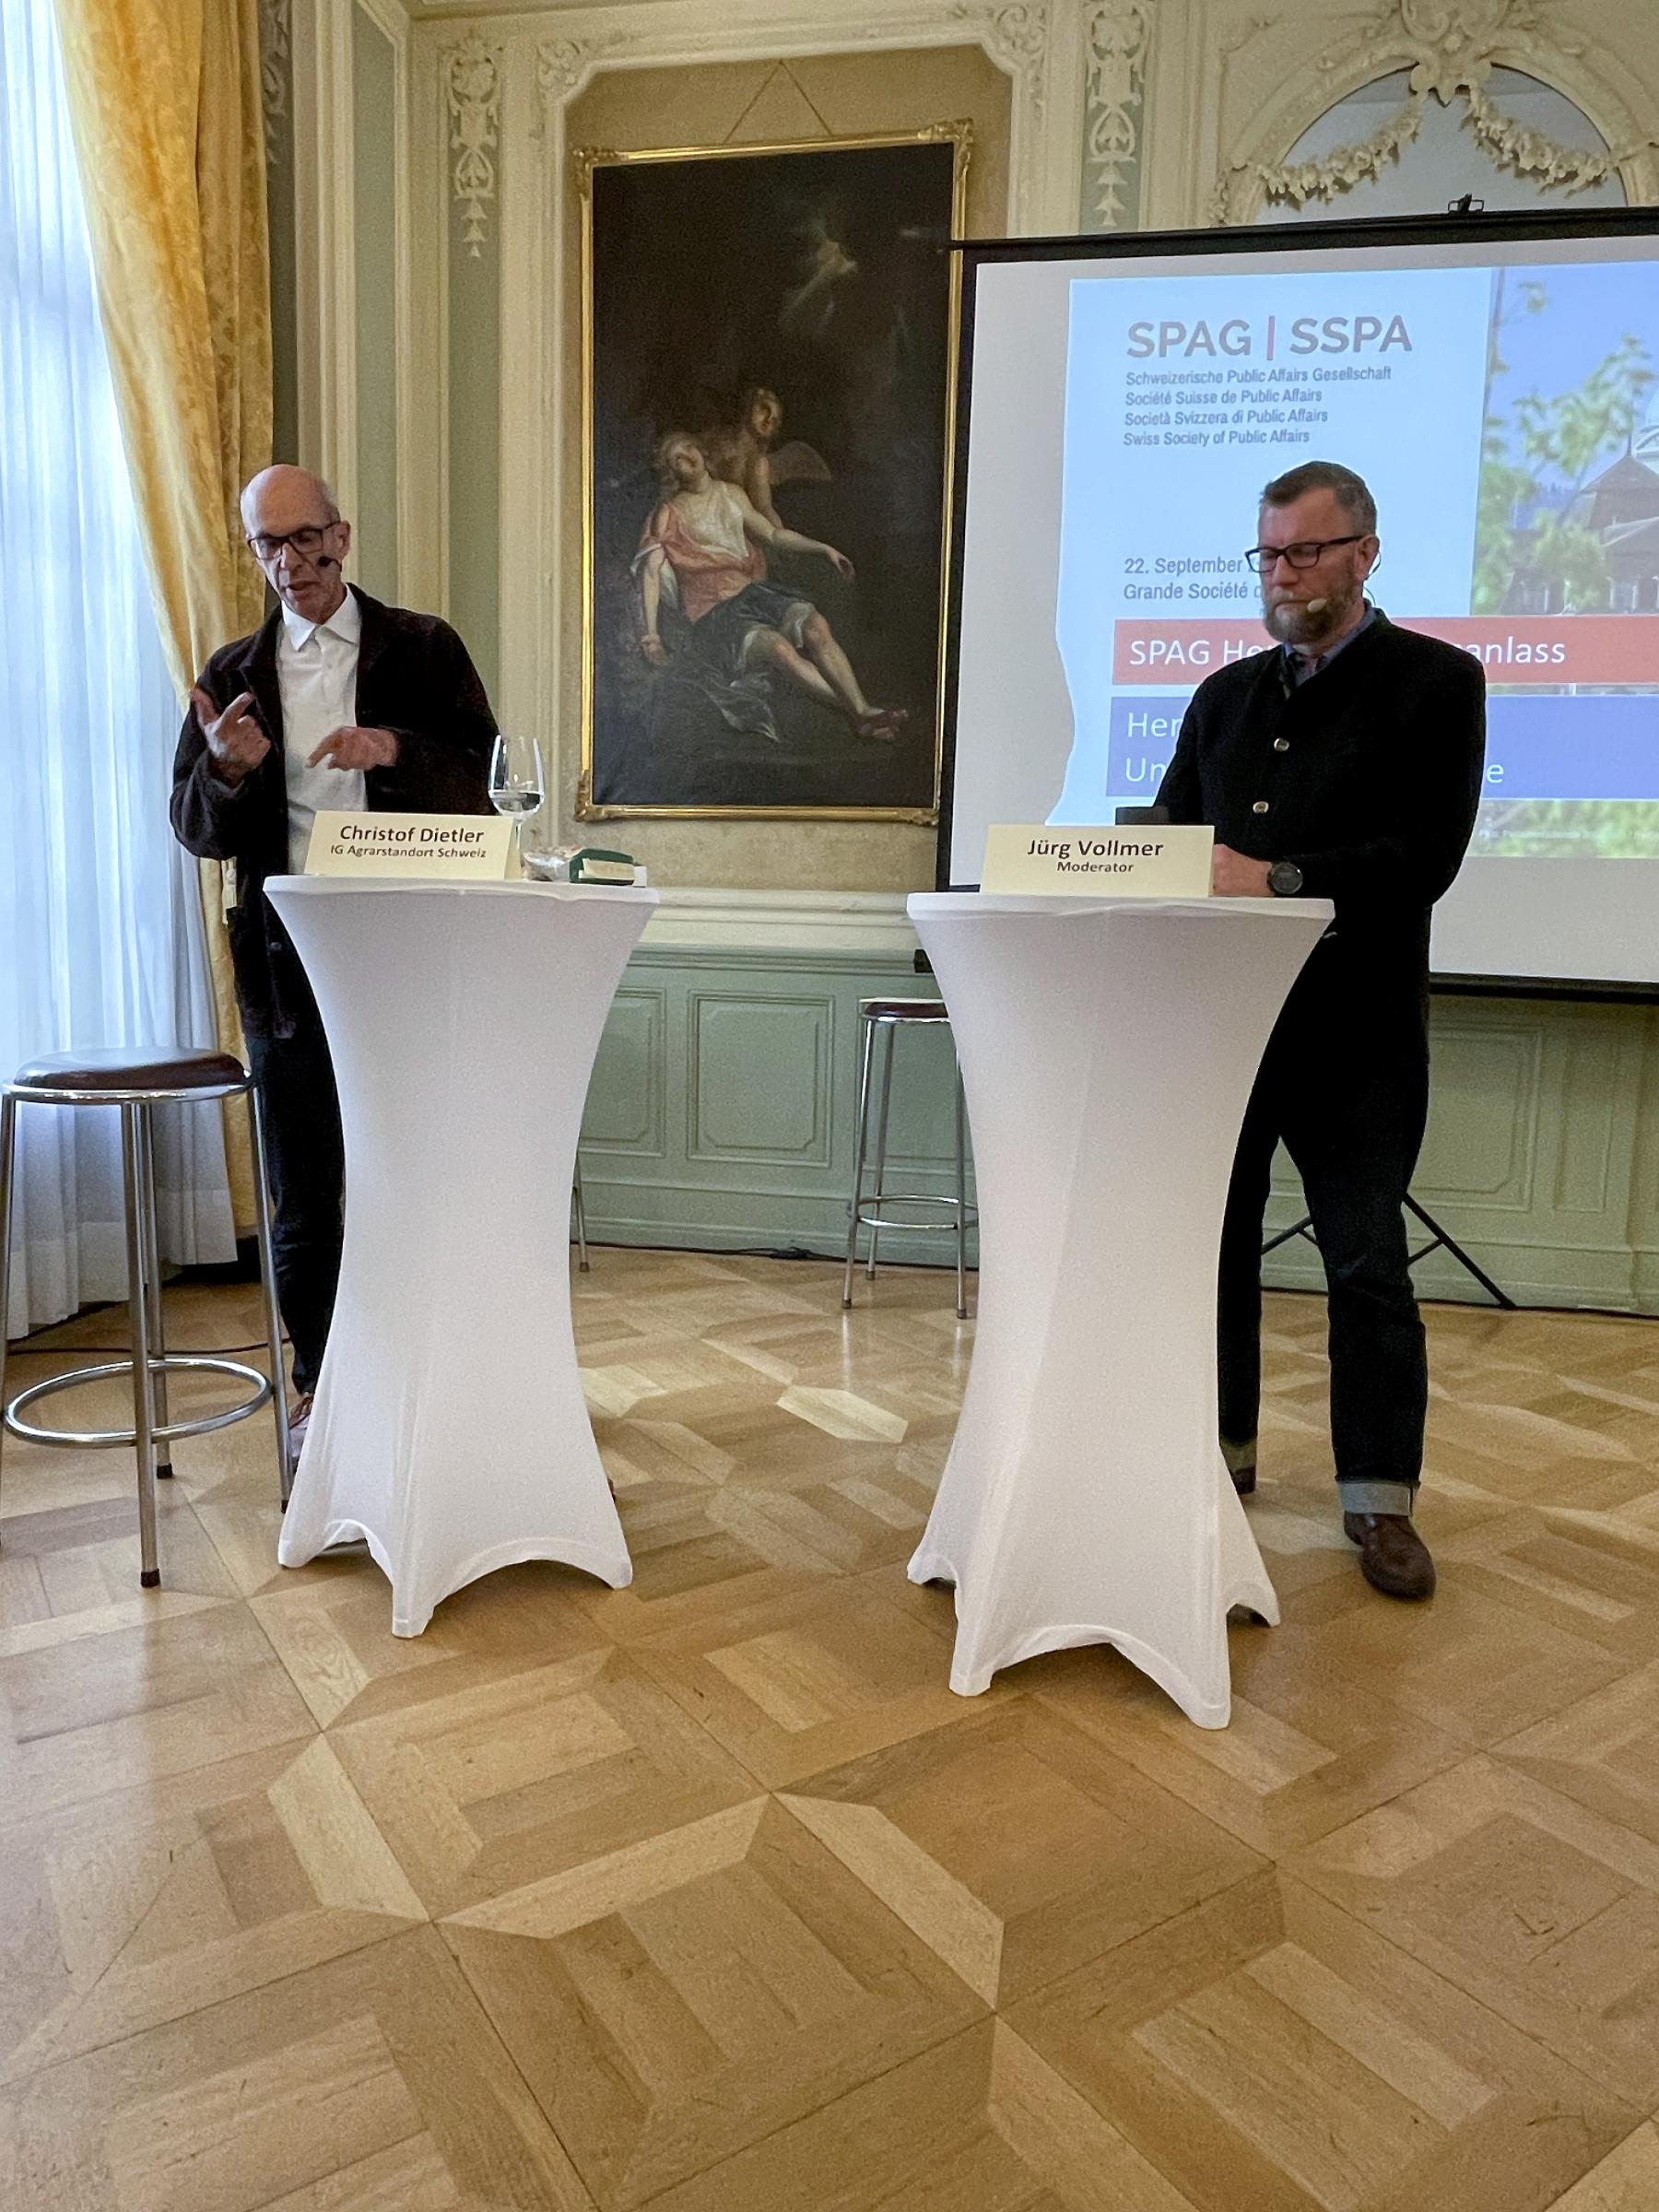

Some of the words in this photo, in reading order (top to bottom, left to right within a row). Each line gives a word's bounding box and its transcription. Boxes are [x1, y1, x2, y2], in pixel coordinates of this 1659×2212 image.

[1126, 319, 1252, 359] SPAG
[1289, 314, 1413, 355] SSPA
[1125, 371, 1223, 385] Schweizerische
[1227, 368, 1265, 383] Public
[1268, 367, 1308, 382] Affairs
[1312, 365, 1392, 382] Gesellschaft
[1125, 390, 1171, 406] Société
[1175, 390, 1218, 405] Suisse
[1221, 390, 1237, 404] de
[1241, 388, 1280, 403] Public
[1282, 388, 1323, 403] Affairs
[1124, 411, 1171, 426] Società
[1174, 410, 1229, 425] Svizzera
[1231, 409, 1243, 424] di
[1247, 409, 1286, 424] Public
[1288, 408, 1328, 423] Affairs
[1124, 432, 1159, 446] Swiss
[1163, 430, 1209, 447] Society
[1213, 430, 1226, 444] of
[1229, 429, 1267, 443] Public
[1269, 429, 1310, 443] Affairs
[1124, 558, 1149, 574] 22.
[1154, 556, 1243, 576] September
[1124, 582, 1183, 599] Grande
[1188, 582, 1248, 599] Société
[1129, 640, 1210, 665] SPAG
[1127, 712, 1183, 737] Her
[339, 825, 415, 842] Christof
[420, 828, 485, 843] Dietler
[330, 844, 344, 855] IG
[347, 845, 433, 858] Agrarstandort
[437, 848, 487, 858] Schweiz
[1028, 840, 1071, 859] Jürg
[1078, 840, 1164, 856] Vollmer
[1056, 861, 1135, 873] Moderator
